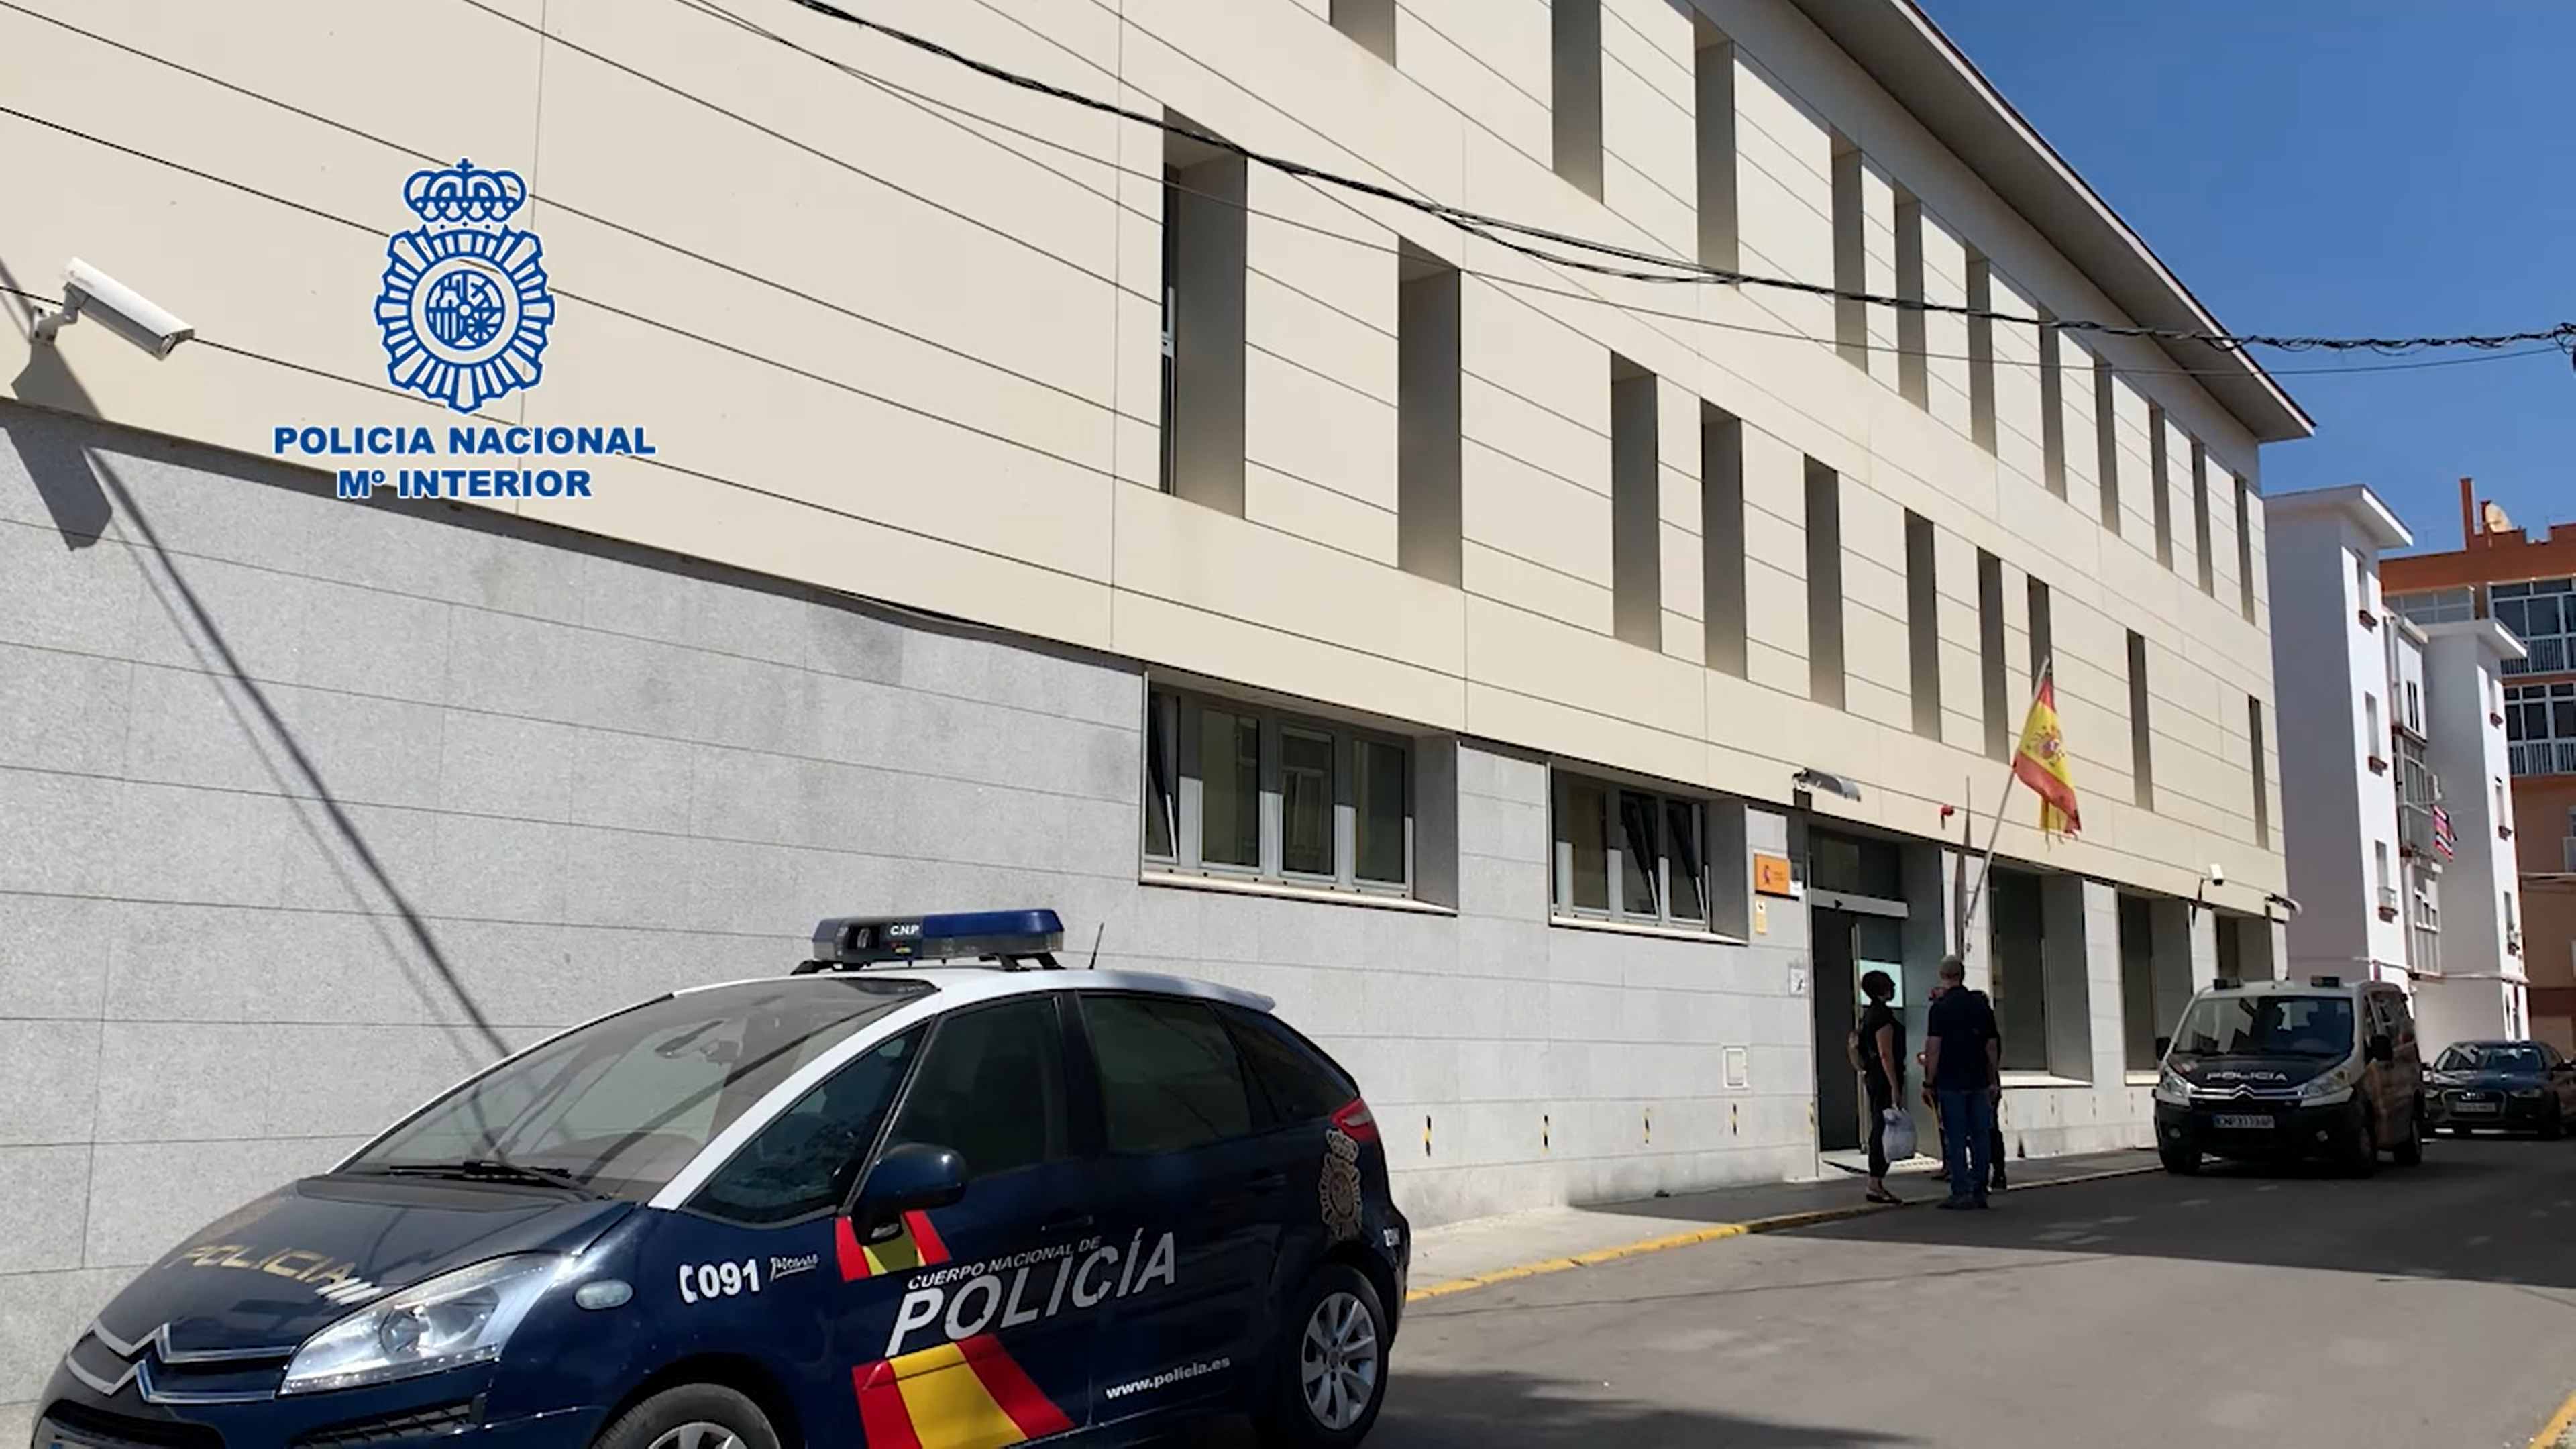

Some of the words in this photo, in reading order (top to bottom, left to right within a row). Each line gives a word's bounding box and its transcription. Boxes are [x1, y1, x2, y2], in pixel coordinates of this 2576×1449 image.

[907, 1261, 985, 1290] CUERPO
[988, 1242, 1074, 1272] NACIONAL
[1077, 1235, 1102, 1253] DE
[883, 1226, 1176, 1358] POLICÍA
[1106, 1356, 1231, 1400] www.policia.es
